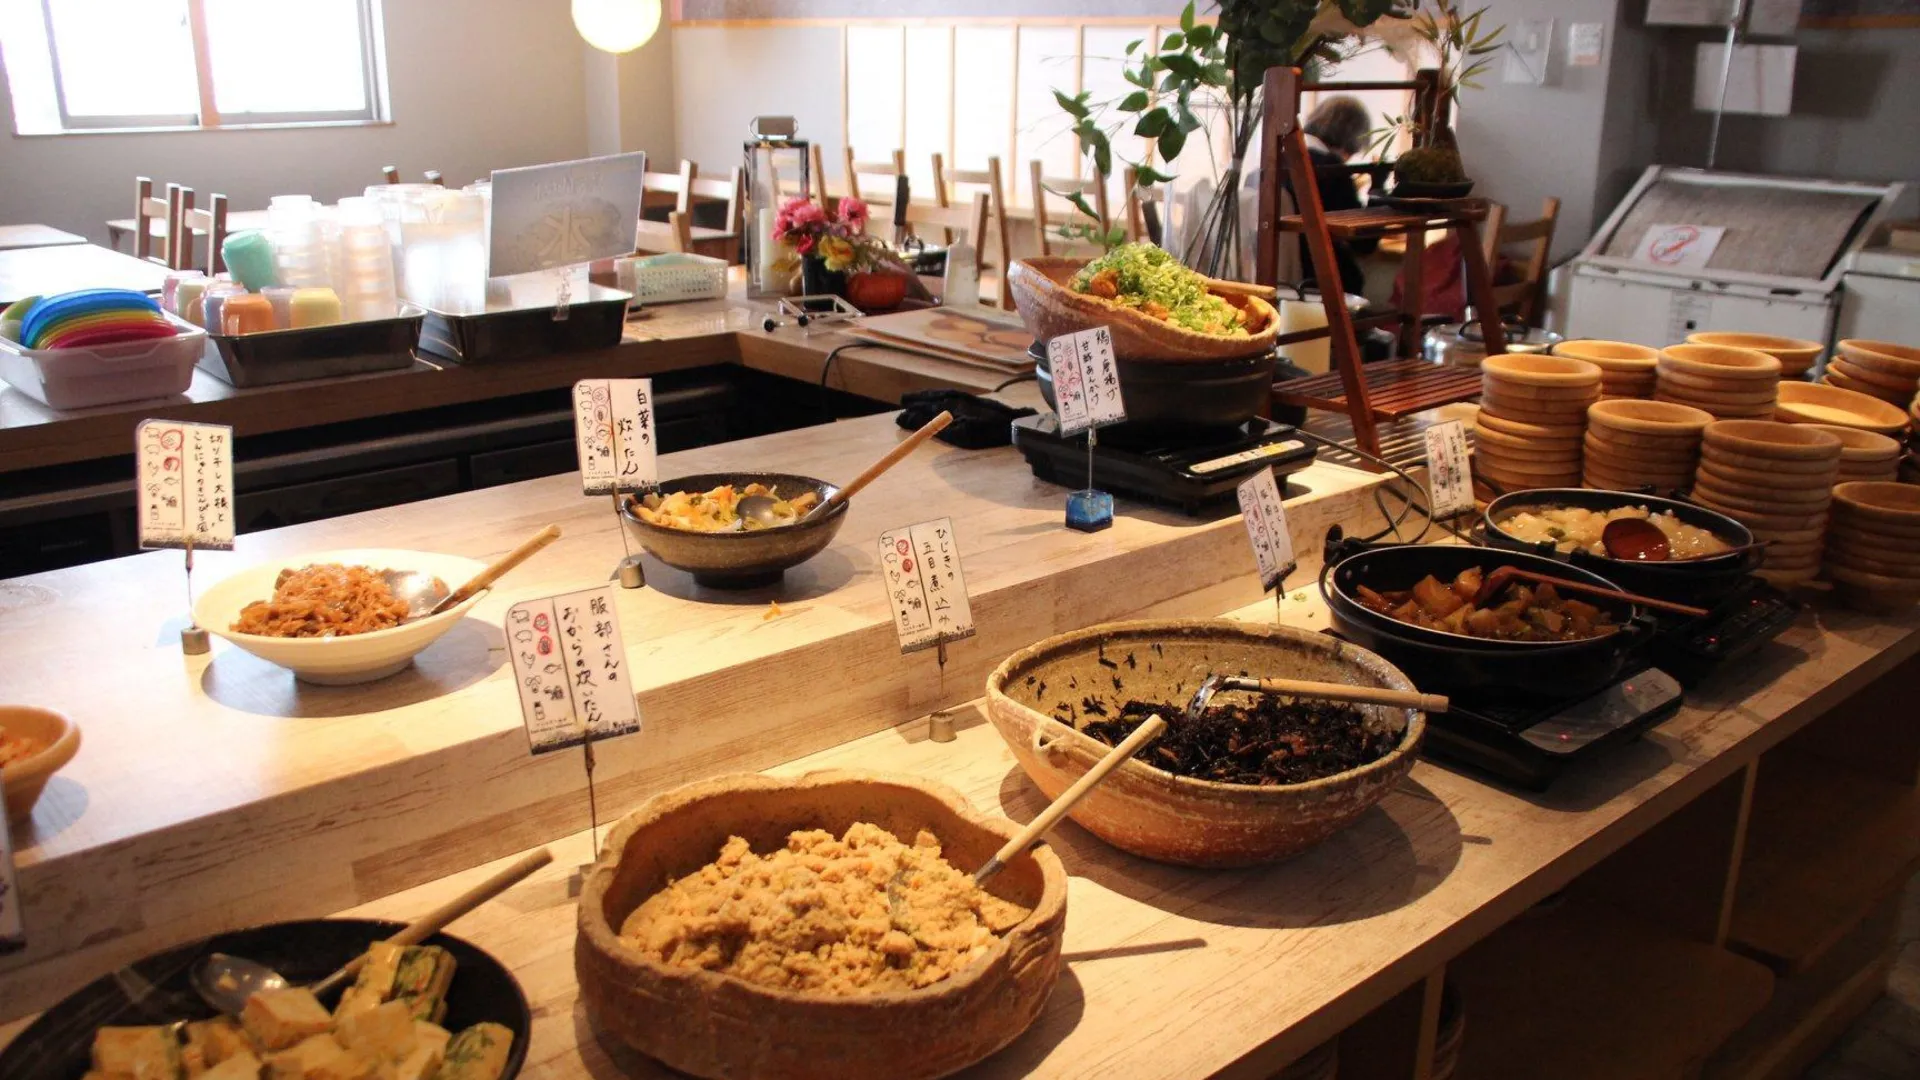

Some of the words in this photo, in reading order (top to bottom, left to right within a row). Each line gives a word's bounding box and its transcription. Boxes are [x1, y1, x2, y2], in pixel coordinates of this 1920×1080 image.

[637, 388, 651, 445] 白菜の
[617, 417, 639, 476] 炊いたん
[935, 528, 954, 581] ひじきの
[563, 606, 603, 722] おからの炊いたん
[590, 596, 620, 682] 服部さんの
